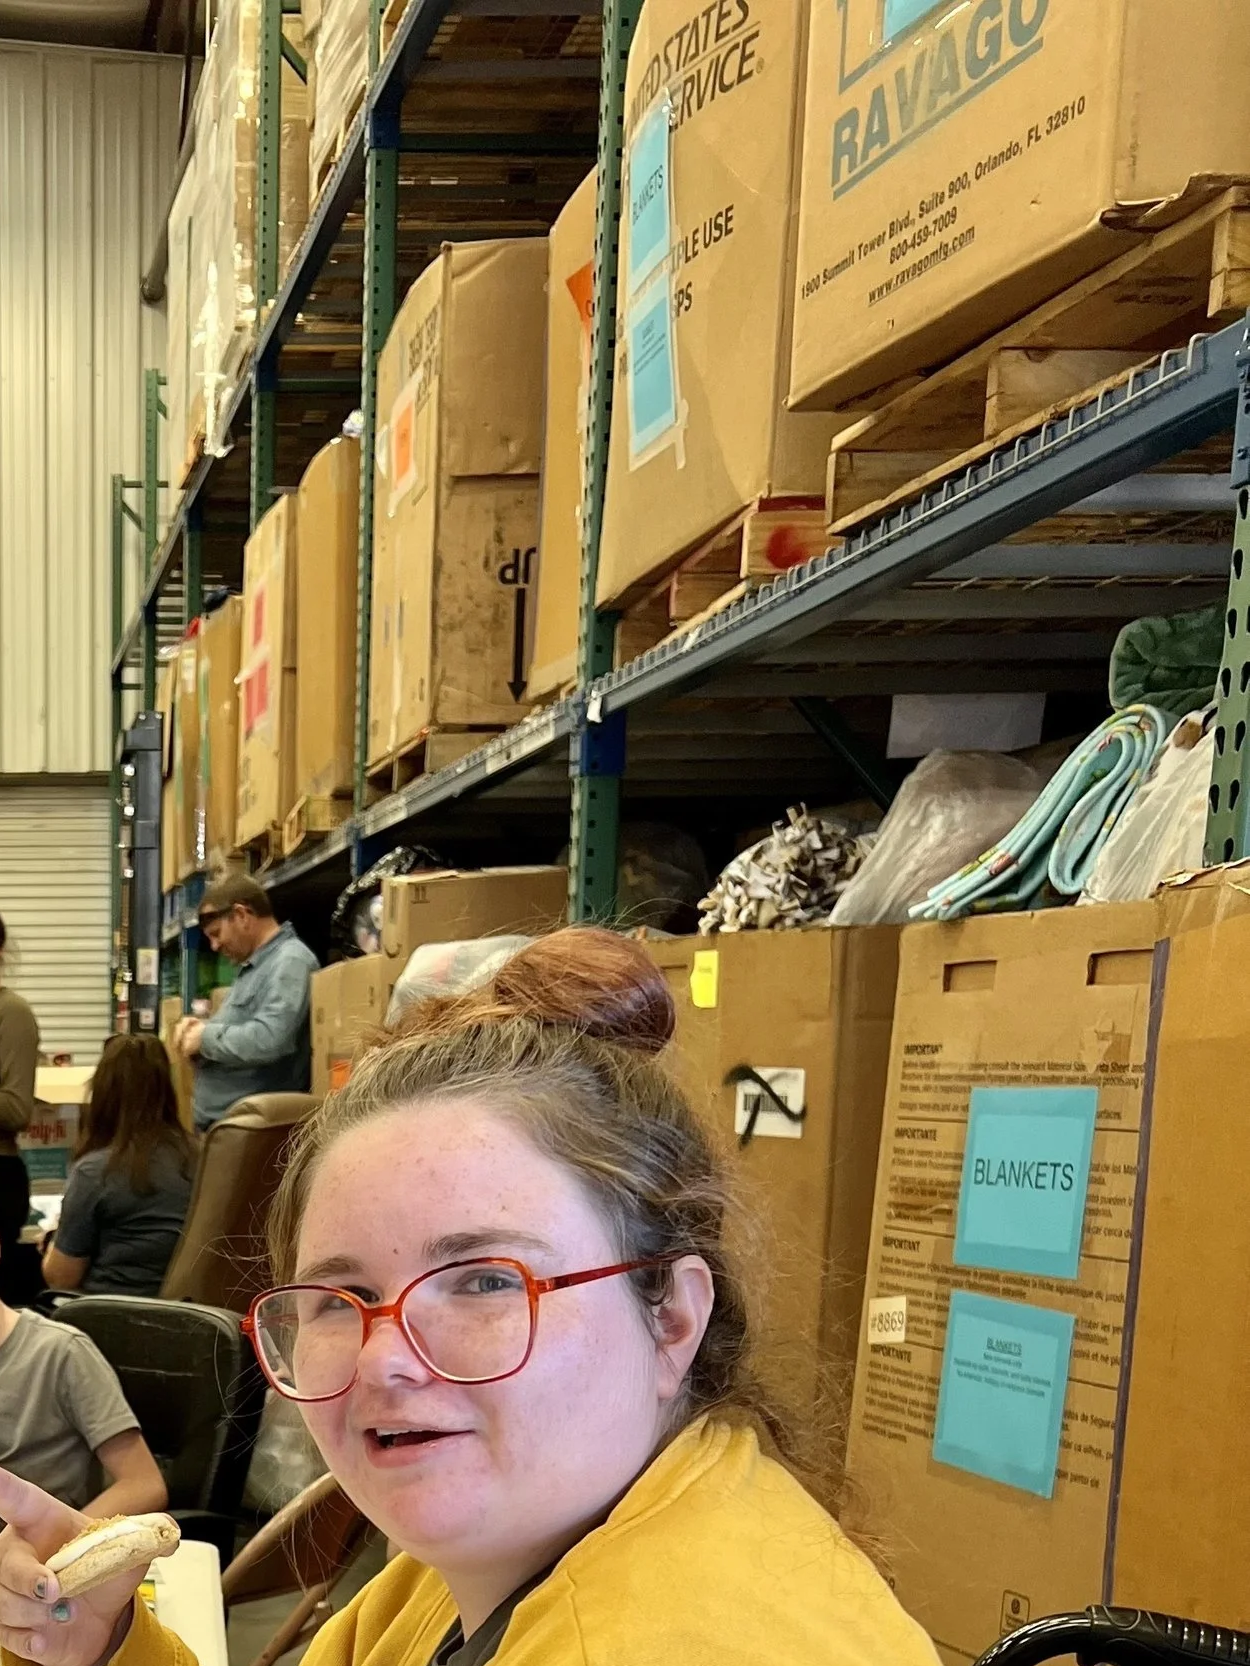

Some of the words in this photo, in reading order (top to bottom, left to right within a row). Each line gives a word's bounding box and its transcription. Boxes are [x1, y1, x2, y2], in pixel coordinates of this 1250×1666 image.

[662, 0, 750, 85] STATES
[669, 29, 760, 131] ERVICE
[831, 0, 1049, 188] RAVAGO
[703, 203, 734, 249] USE
[802, 274, 820, 300] 1900
[822, 251, 855, 285] Summit
[858, 230, 887, 260] Tower
[918, 190, 945, 218] Suite
[974, 141, 1023, 181] Orlando,
[1027, 127, 1041, 148] FL
[1046, 96, 1086, 136] 32810
[890, 206, 958, 265] 800-459-7009
[868, 226, 975, 304] www.ravagomfg.com
[973, 1158, 1075, 1192] BLANKETS
[870, 1310, 906, 1333] #8869
